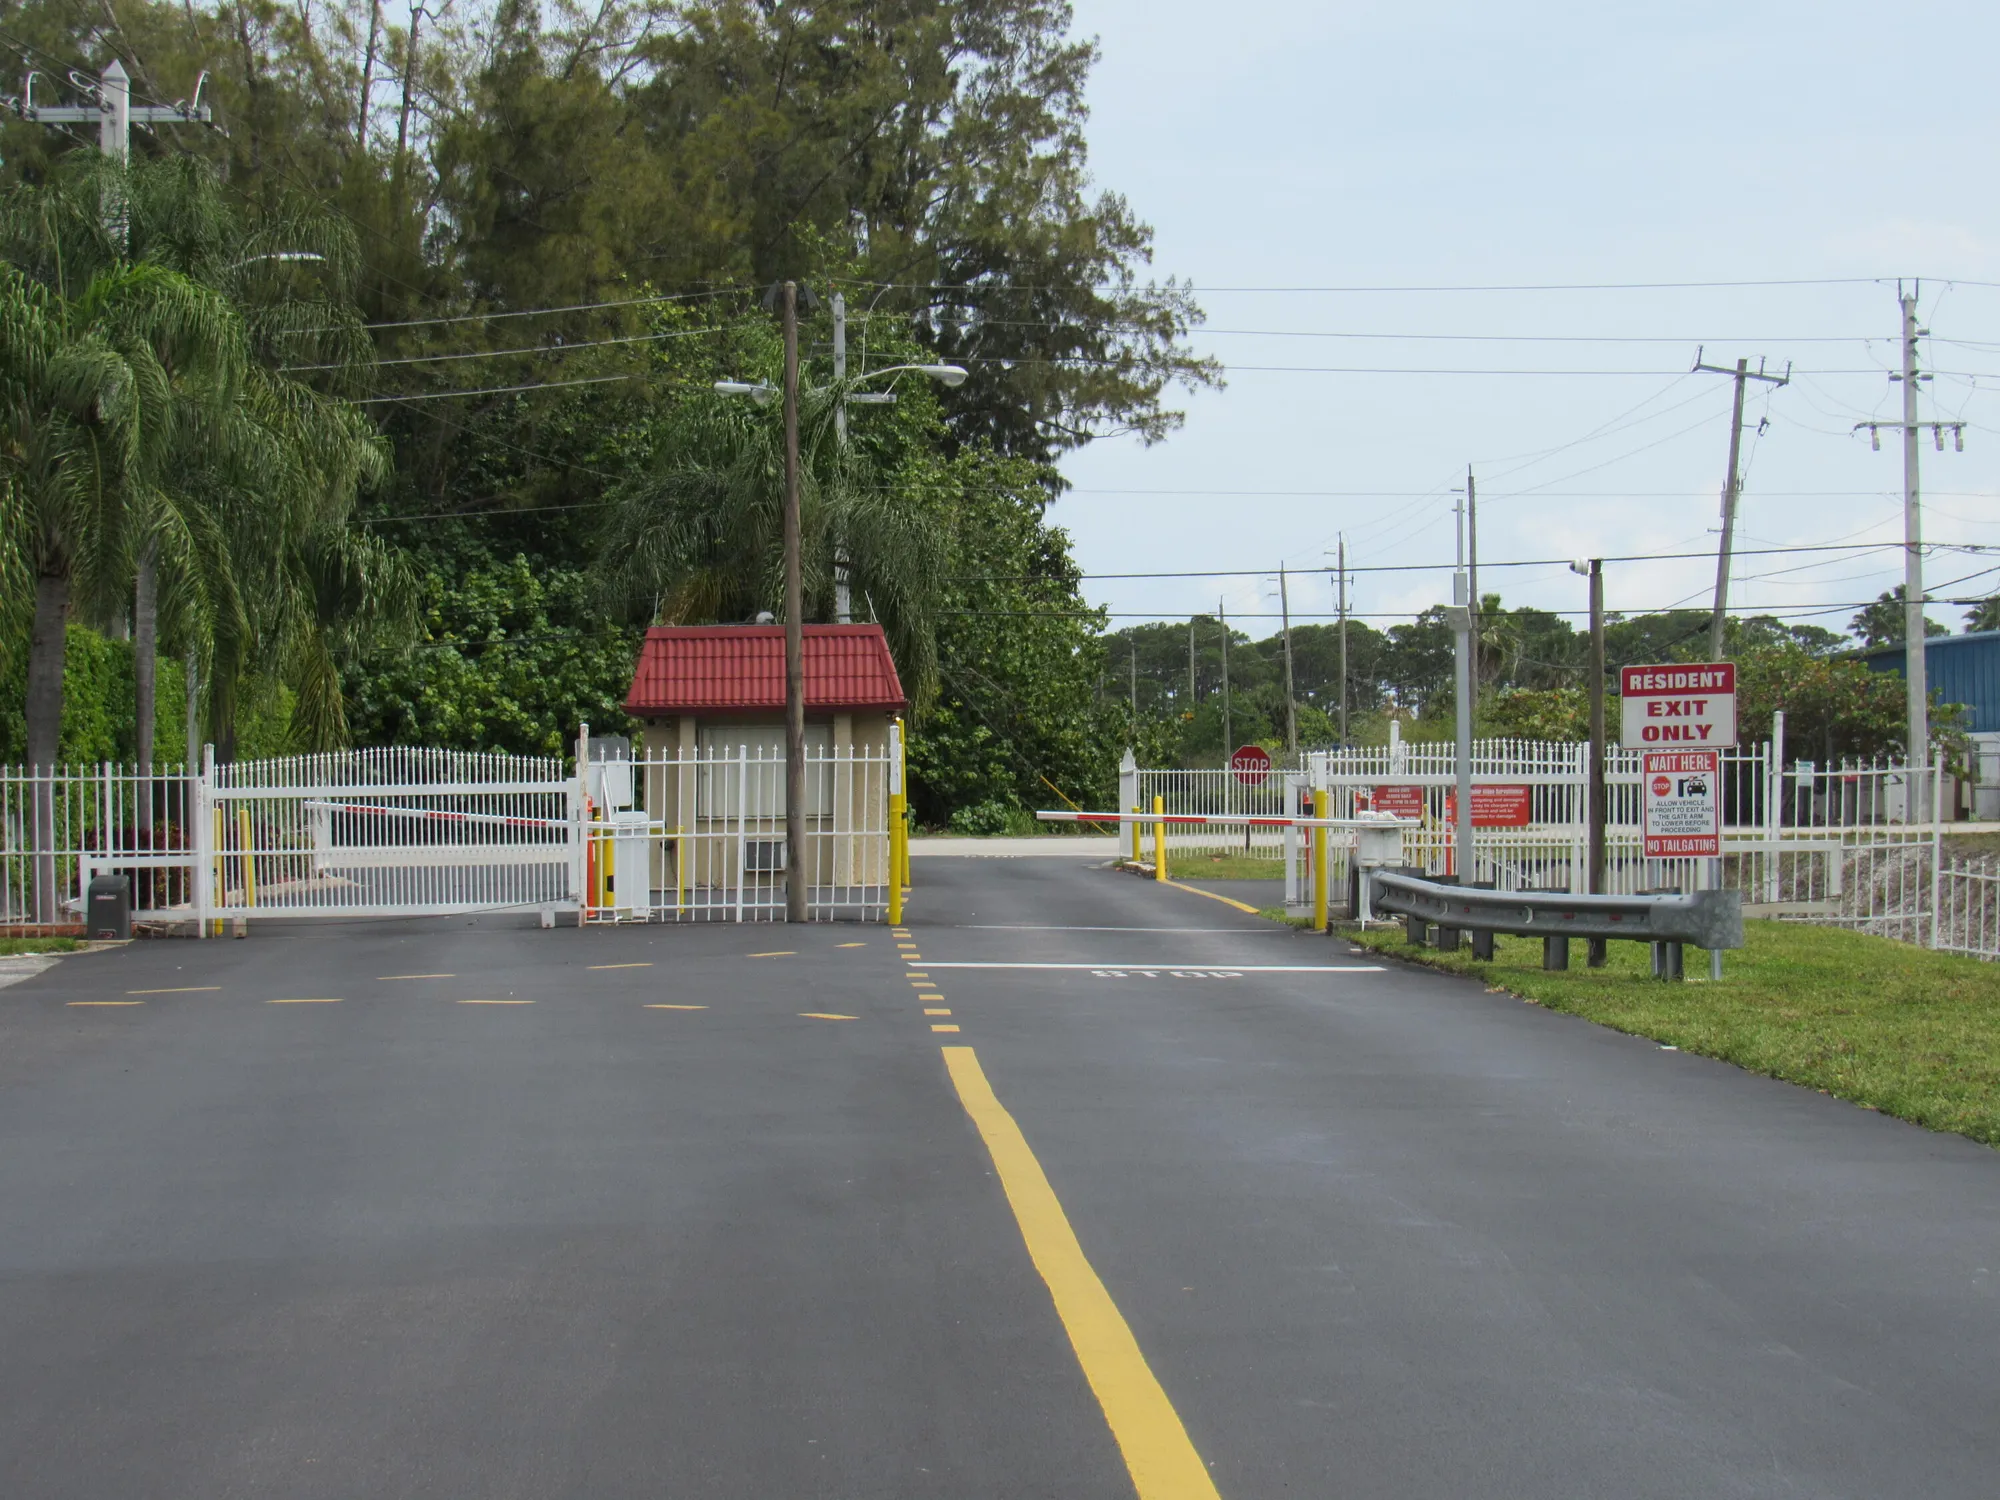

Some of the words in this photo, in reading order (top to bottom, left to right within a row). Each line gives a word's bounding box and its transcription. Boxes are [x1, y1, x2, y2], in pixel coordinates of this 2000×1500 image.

[1630, 672, 1726, 690] RESIDENT
[1647, 700, 1708, 717] EXIT
[1642, 724, 1713, 742] ONLY
[1234, 758, 1268, 772] STOP
[1649, 756, 1677, 771] WAIT
[1681, 754, 1712, 770] HERE
[1648, 840, 1660, 852] NO
[1662, 839, 1716, 852] TAILGATING
